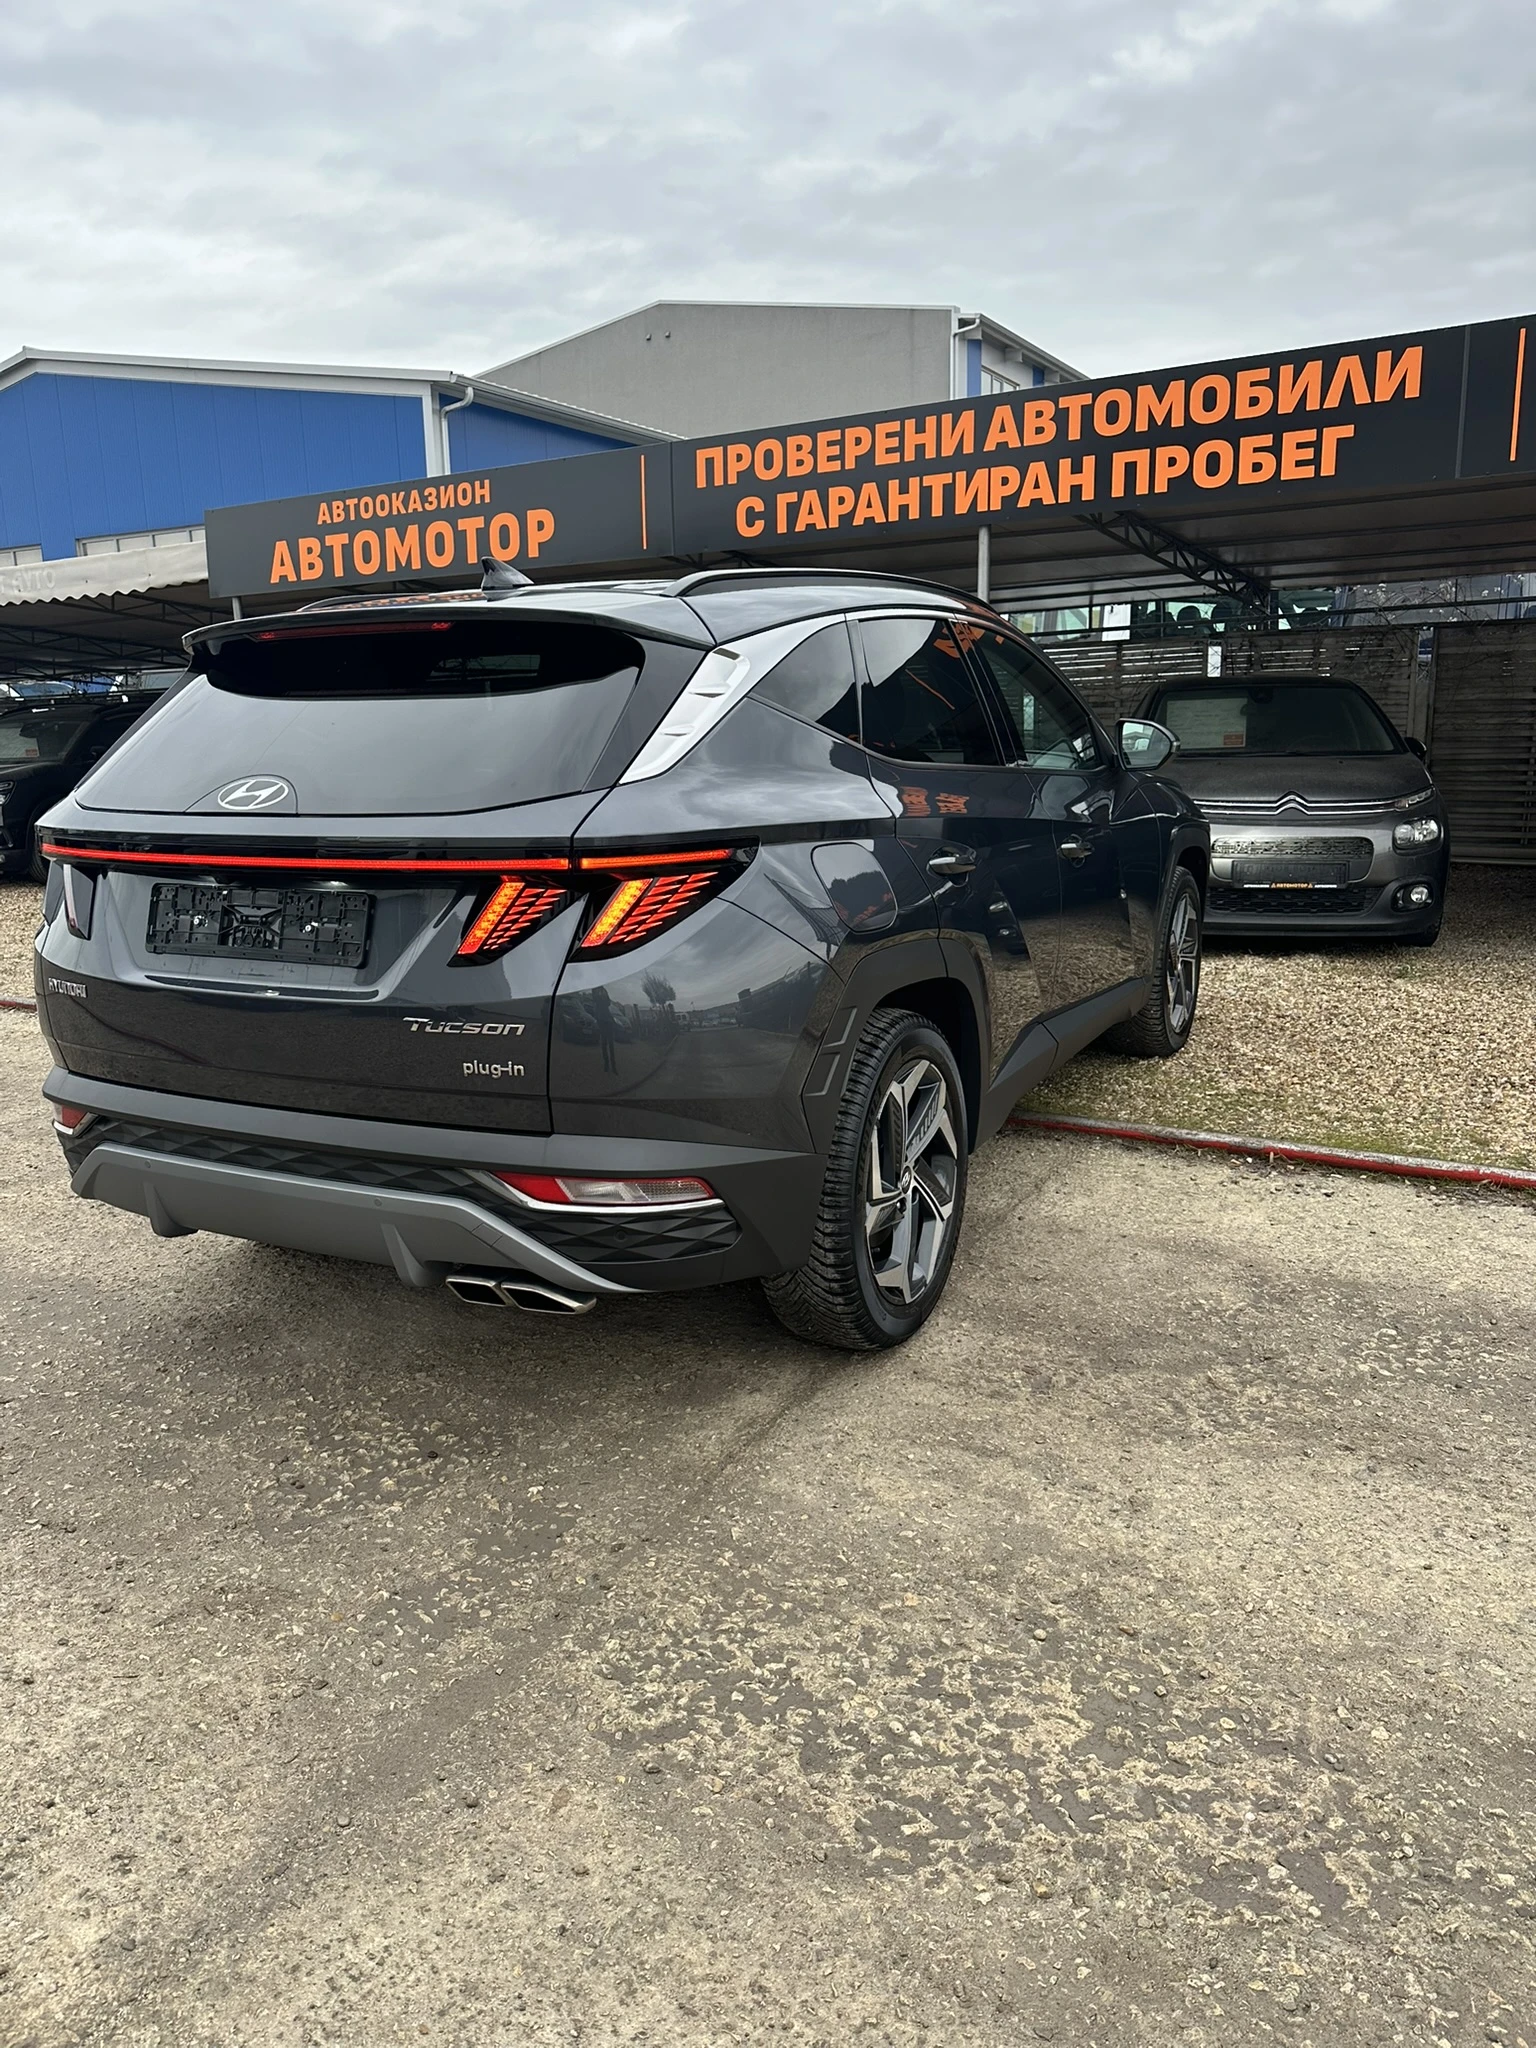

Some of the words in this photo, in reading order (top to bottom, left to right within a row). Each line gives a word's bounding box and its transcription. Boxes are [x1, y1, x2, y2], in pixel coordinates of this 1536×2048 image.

[695, 409, 975, 489] ПРОВЕРЕНИ
[983, 346, 1423, 452] АВТОМОБИЛИ
[317, 479, 491, 525] АВТООКАЗИОН
[735, 496, 765, 538] С
[776, 454, 1096, 535] ГАРАНТИРАН
[1110, 424, 1355, 498] ПРОБЕГ
[270, 508, 555, 584] АВТОМОТОР
[462, 1059, 525, 1079] plug-in
